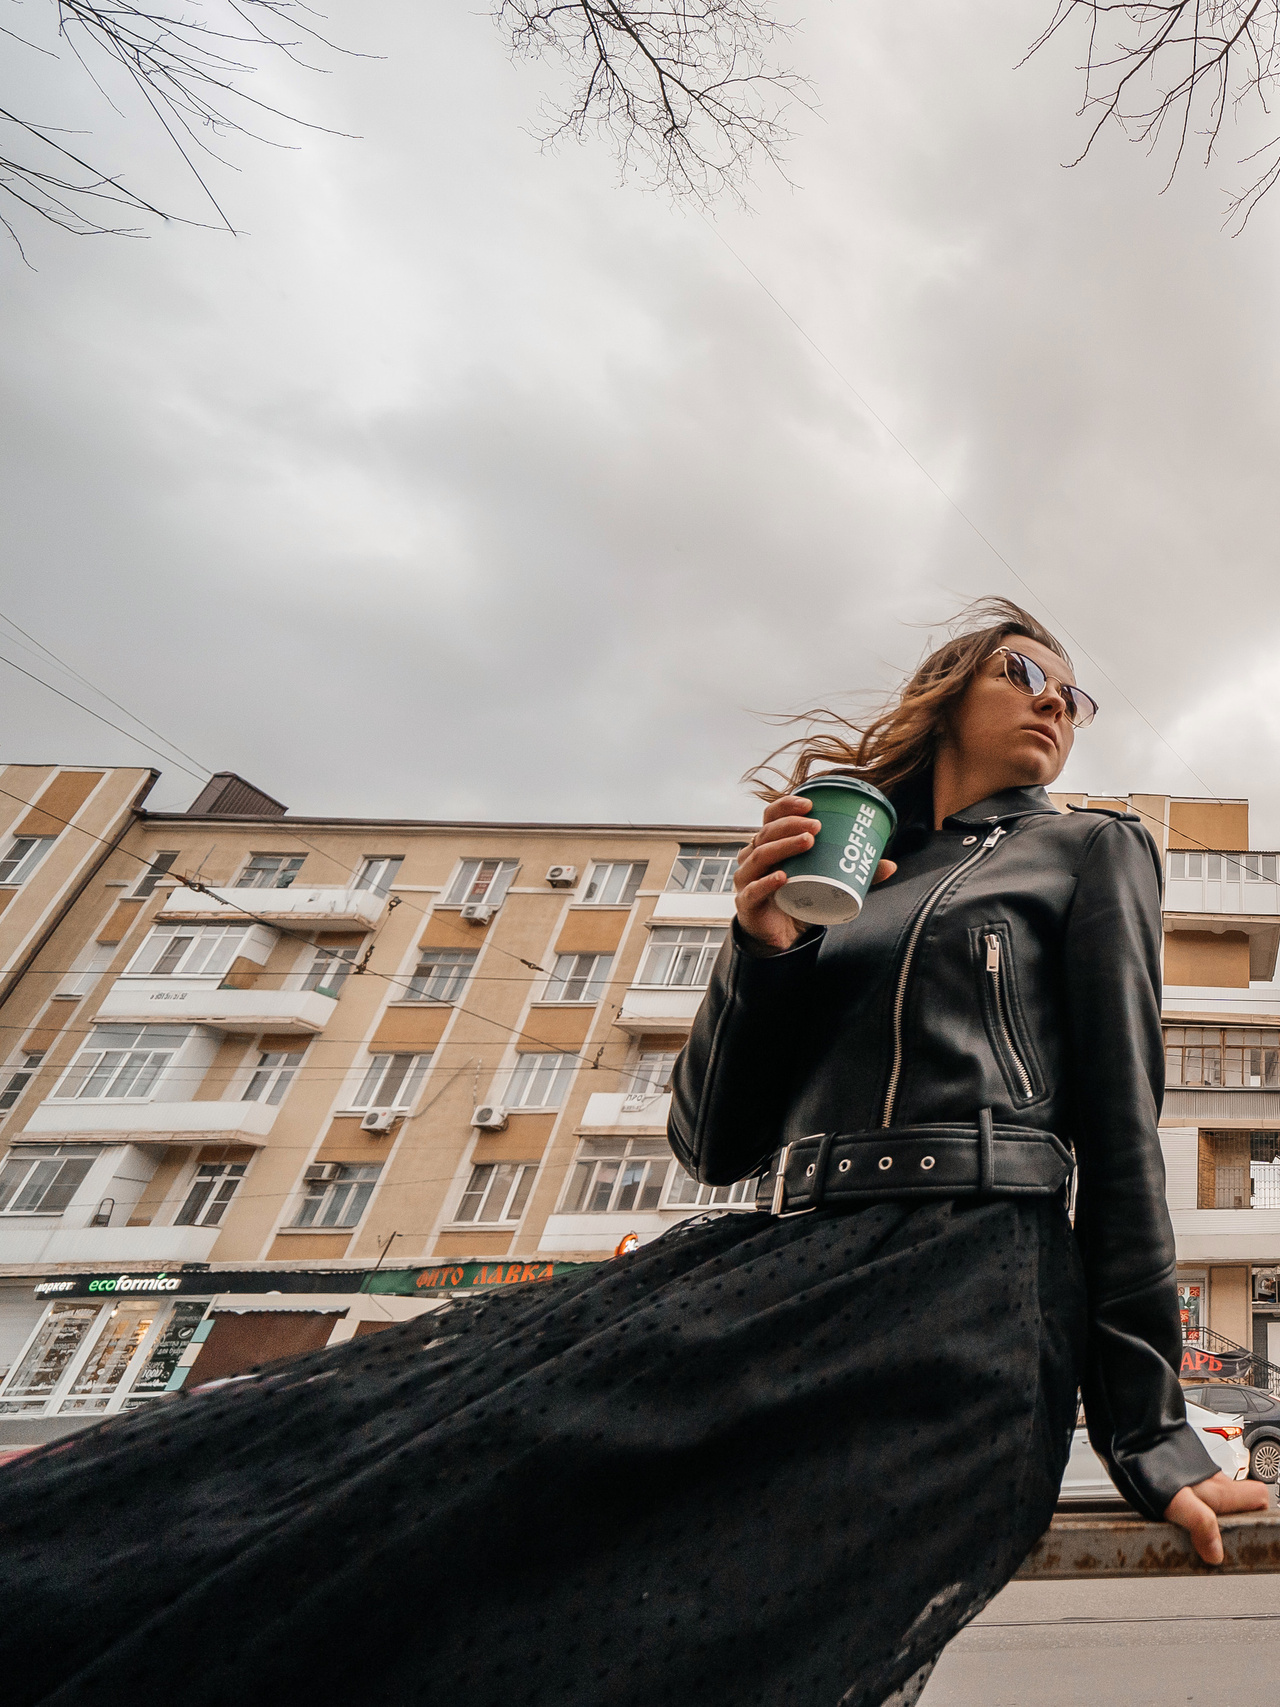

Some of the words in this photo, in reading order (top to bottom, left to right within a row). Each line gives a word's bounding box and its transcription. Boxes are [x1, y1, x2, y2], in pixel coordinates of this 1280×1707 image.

[839, 803, 876, 874] COFFEE
[855, 842, 877, 886] LIKE
[88, 1273, 182, 1292] ecoformica
[472, 1263, 554, 1285] ЛАВКА
